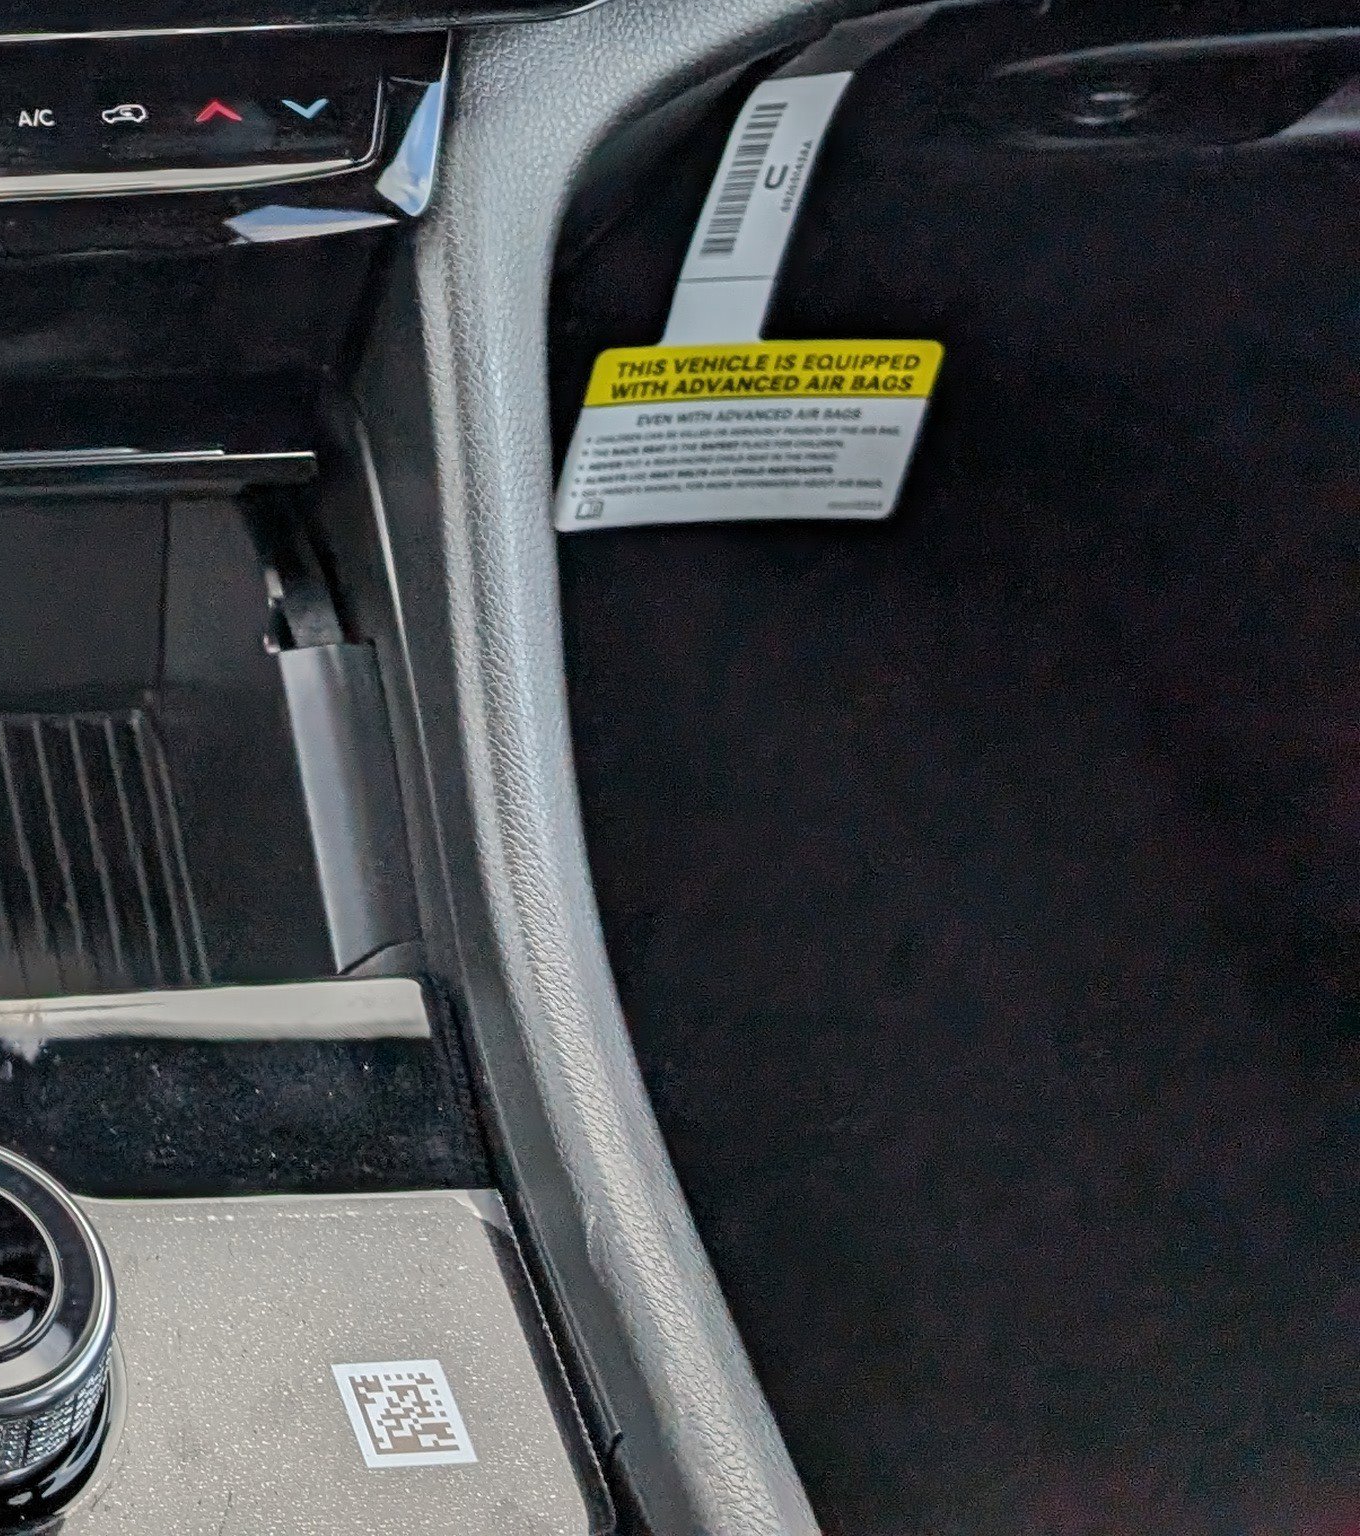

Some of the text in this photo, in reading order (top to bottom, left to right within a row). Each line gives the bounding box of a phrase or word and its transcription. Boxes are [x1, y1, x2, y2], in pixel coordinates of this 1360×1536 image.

[18, 108, 55, 129] A/C
[617, 353, 921, 378] THIS VEHICLE IS EQUIPPED
[611, 374, 914, 400] WITH ADVANCED AIR BAGS
